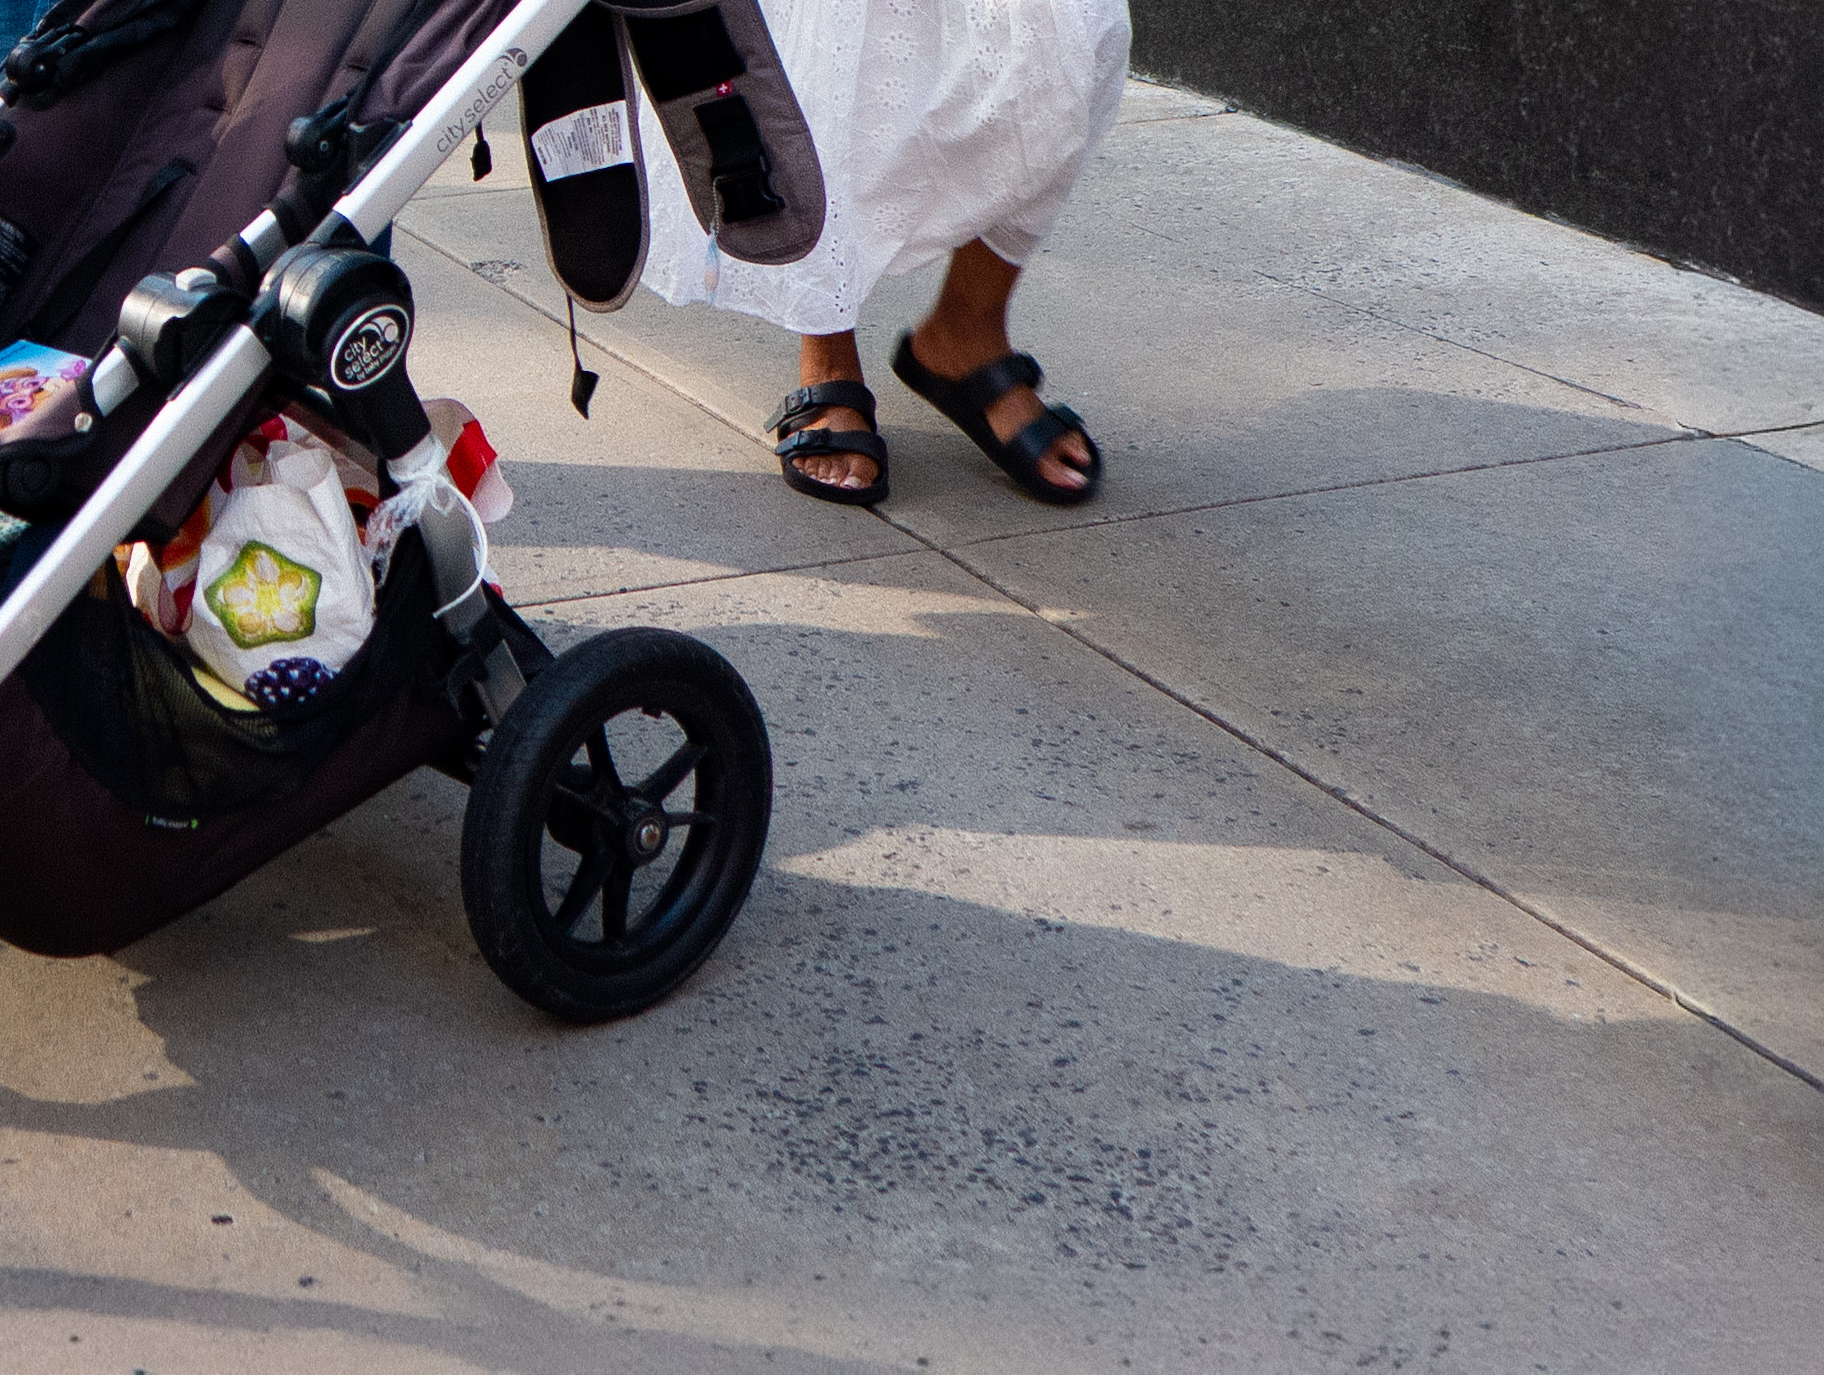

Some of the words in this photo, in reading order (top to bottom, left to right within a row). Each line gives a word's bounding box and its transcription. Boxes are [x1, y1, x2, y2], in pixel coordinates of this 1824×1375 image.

[436, 117, 465, 153] city
[464, 67, 513, 124] select
[344, 336, 366, 362] city
[344, 341, 384, 380] select
